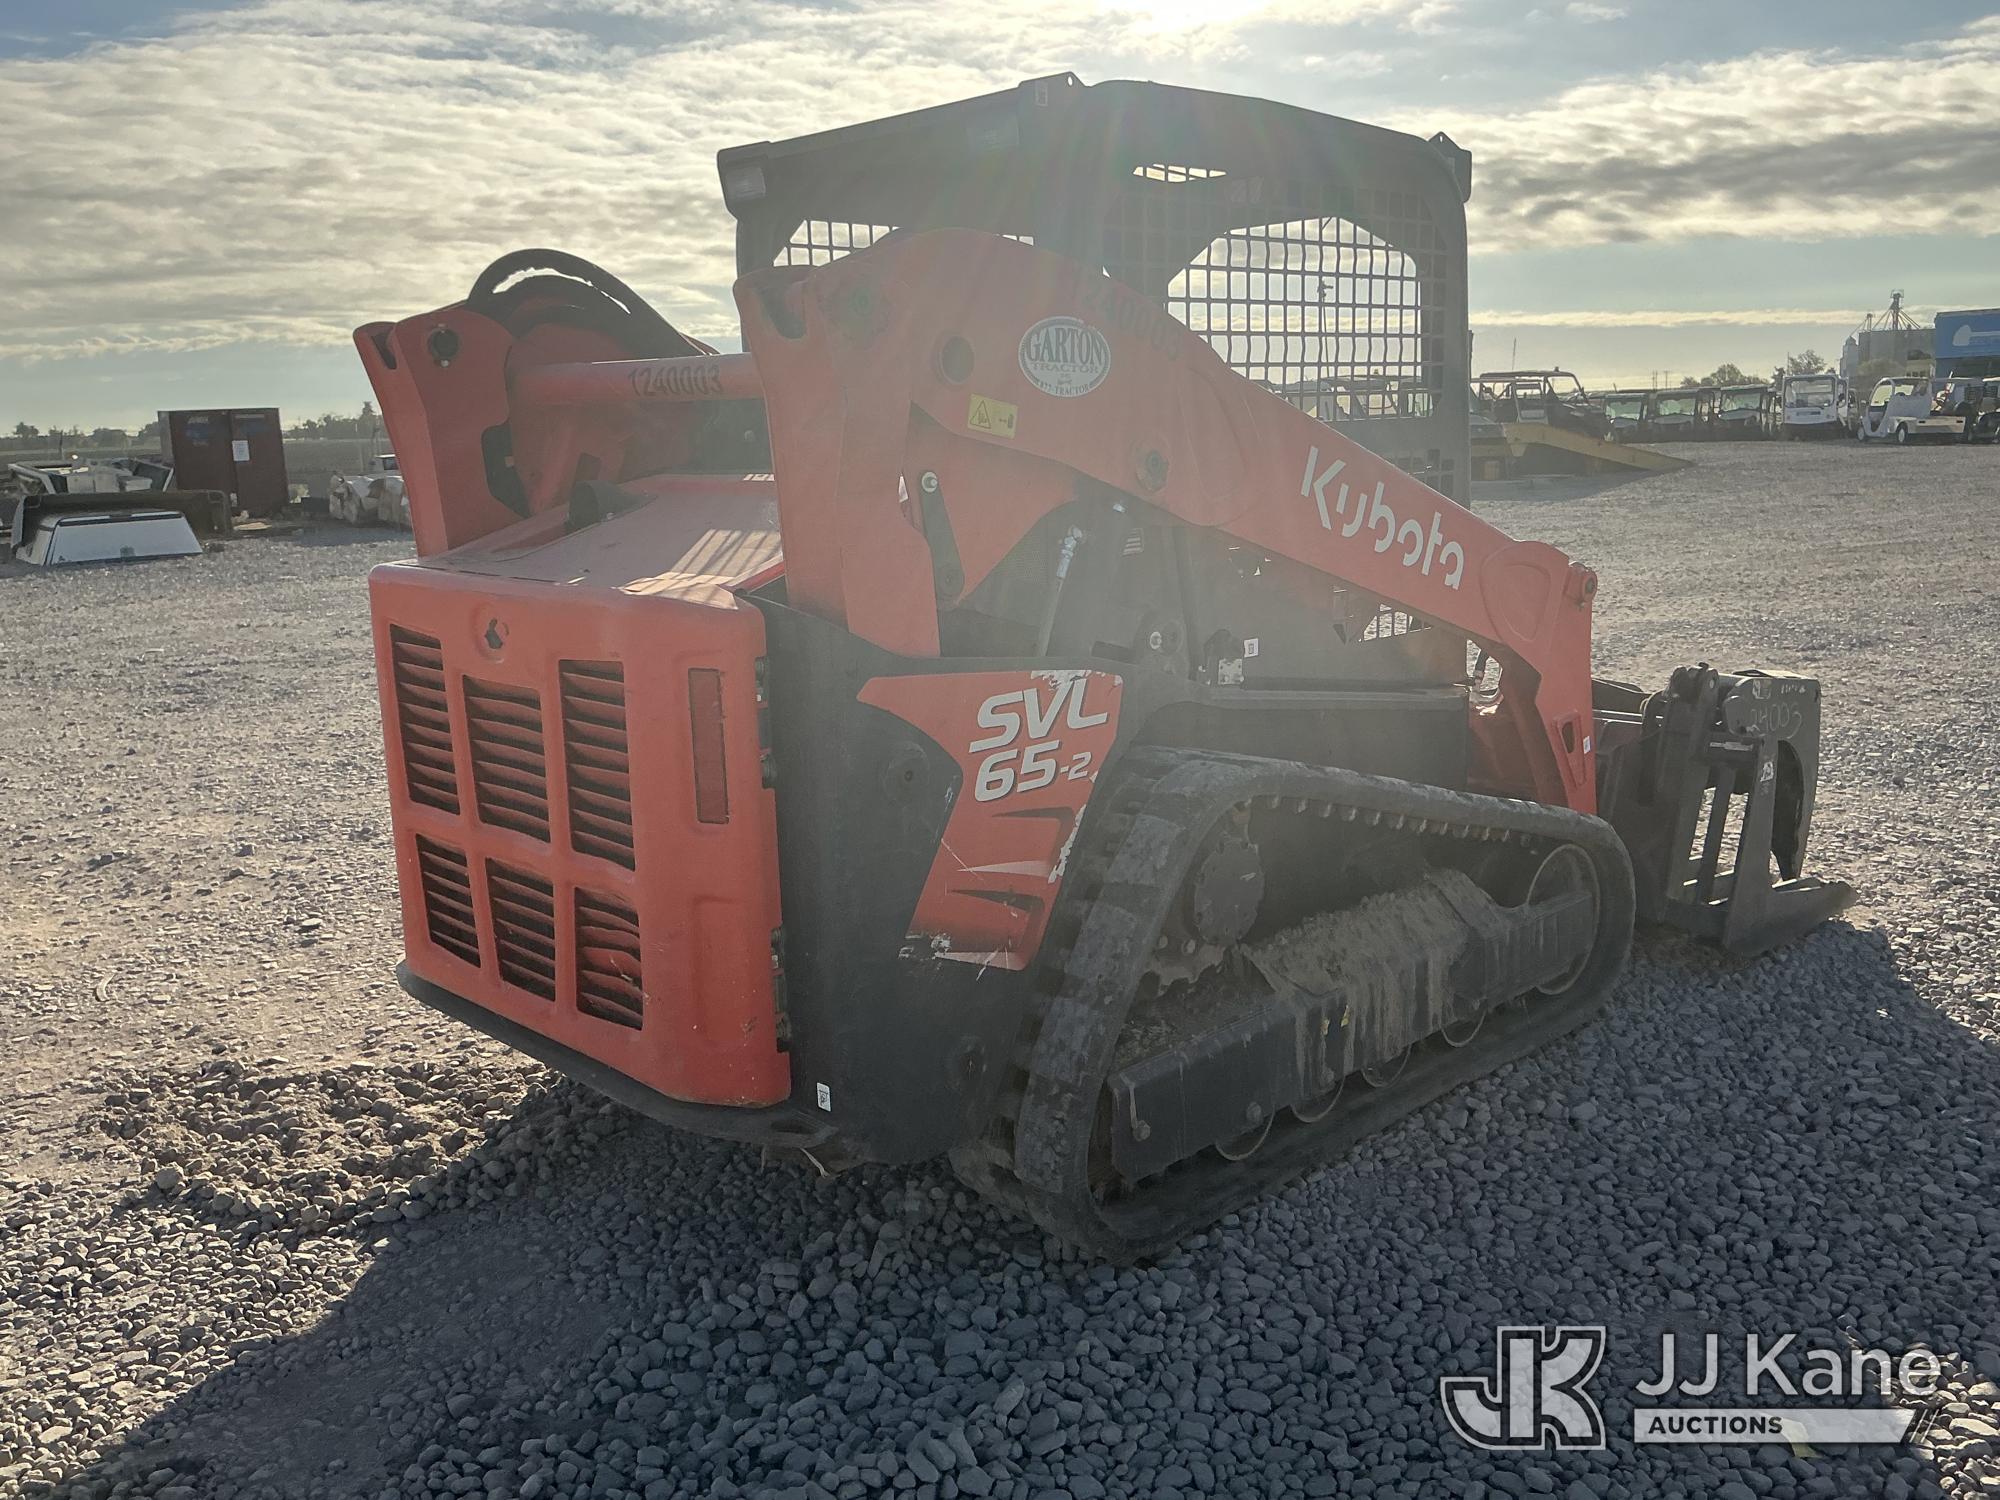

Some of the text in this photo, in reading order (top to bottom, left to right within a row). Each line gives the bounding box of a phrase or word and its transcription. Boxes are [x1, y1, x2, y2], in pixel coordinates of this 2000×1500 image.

[1026, 327, 1104, 366] GARTON
[1031, 361, 1099, 374] TRACTOR
[628, 364, 725, 397] 1240003
[1301, 445, 1464, 590] Kubota
[969, 678, 1108, 753] SVL
[975, 740, 1092, 802] 65-2
